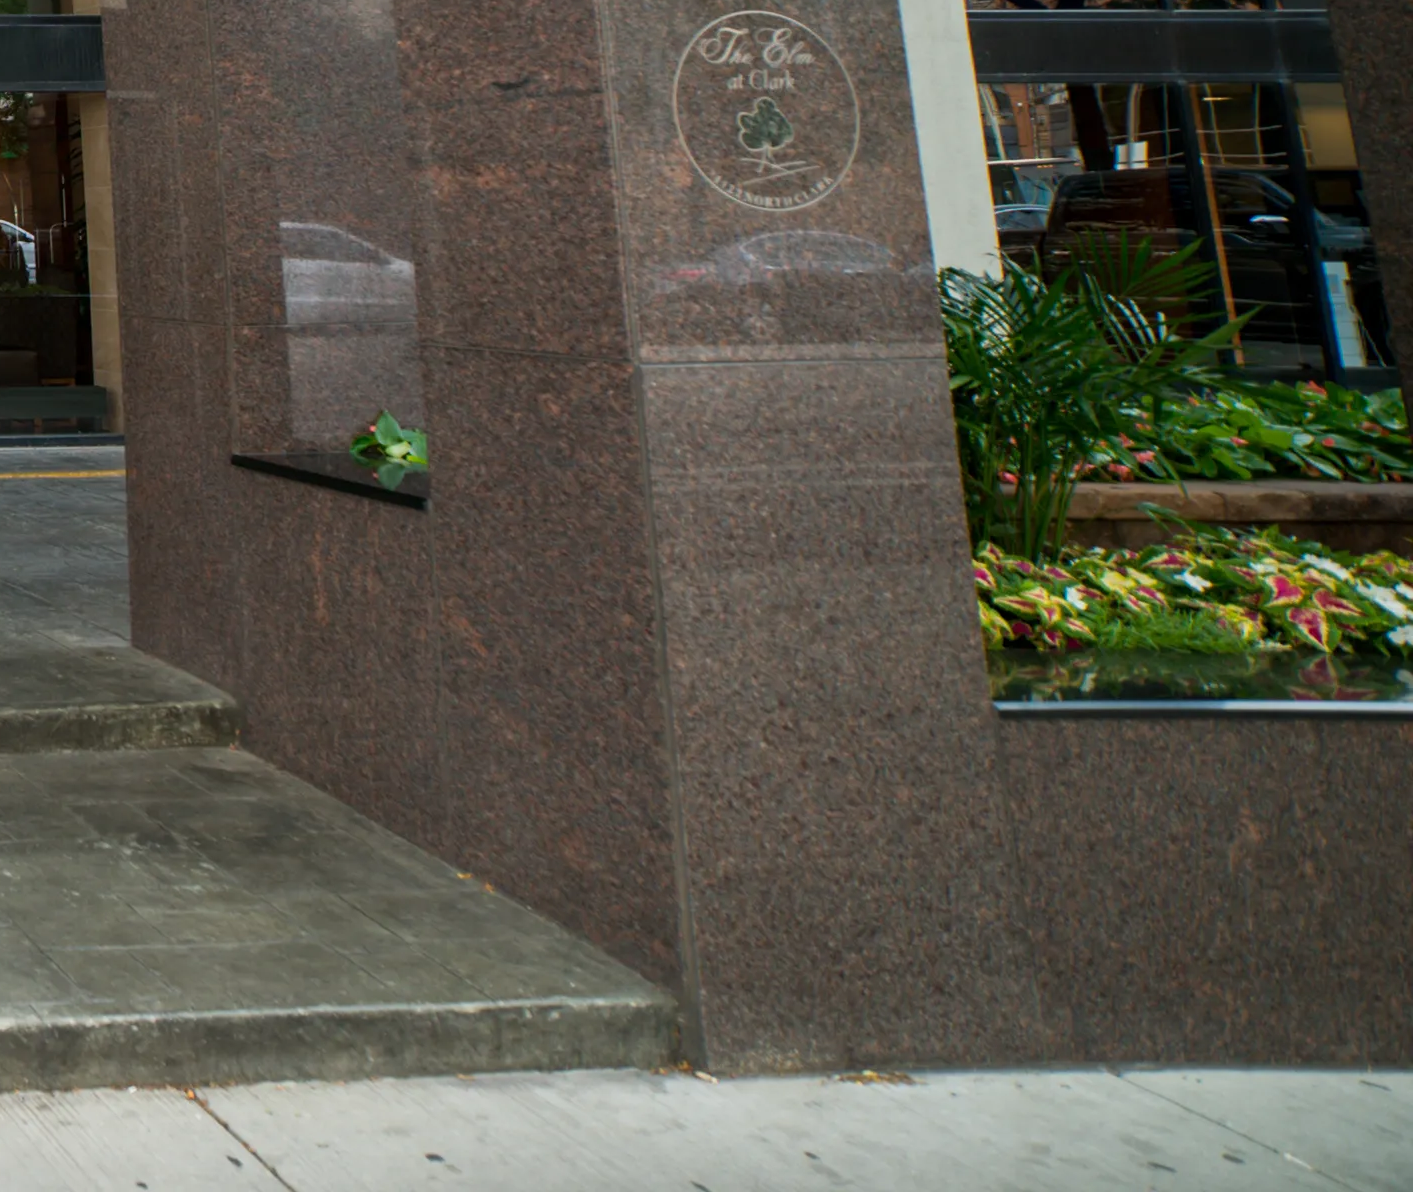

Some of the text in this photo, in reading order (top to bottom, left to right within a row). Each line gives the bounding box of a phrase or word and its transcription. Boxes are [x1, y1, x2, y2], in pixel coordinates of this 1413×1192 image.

[697, 27, 816, 68] The Elm
[727, 69, 796, 89] at Clark
[744, 190, 793, 208] NORTH
[793, 175, 835, 204] CLARK
